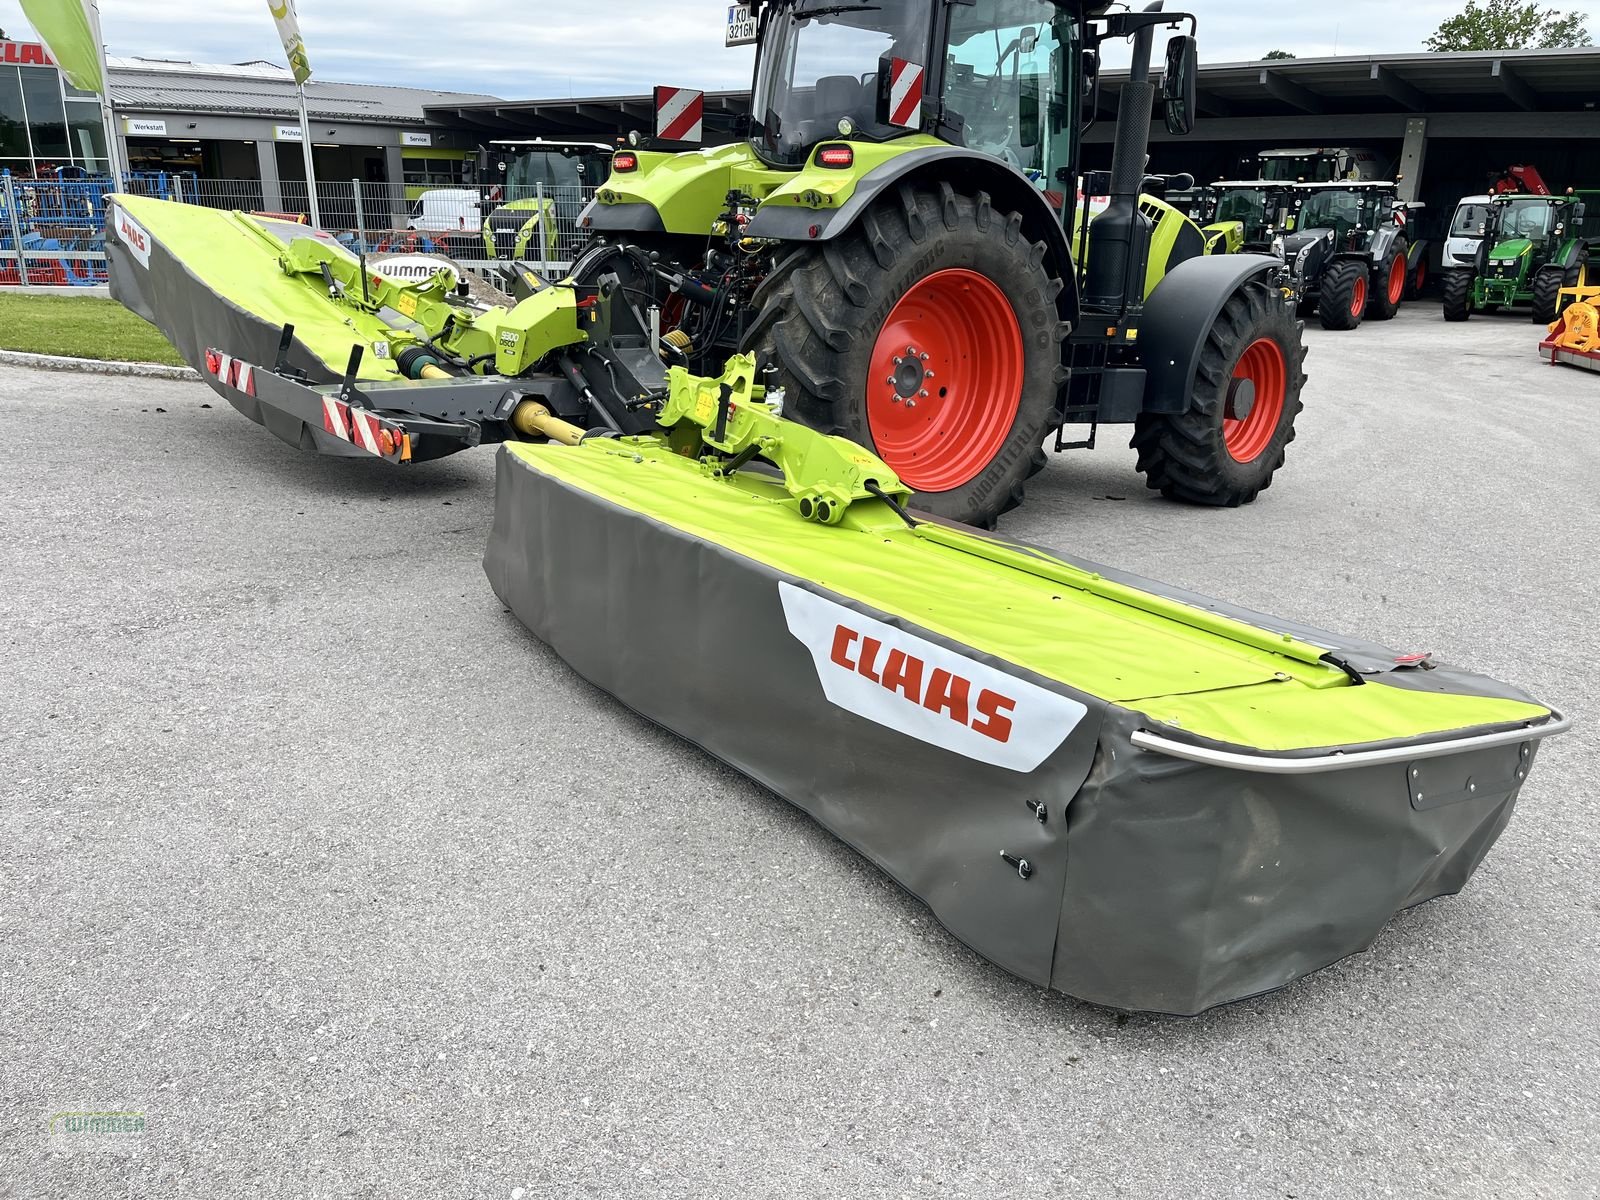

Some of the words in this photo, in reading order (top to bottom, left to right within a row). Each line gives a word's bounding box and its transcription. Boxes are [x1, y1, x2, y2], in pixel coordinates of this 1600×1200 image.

[736, 8, 747, 23] KO
[729, 22, 754, 39] 321GN
[134, 123, 164, 131] Werkstatt
[281, 129, 301, 137] Prüfsta
[409, 135, 428, 143] Service
[499, 338, 516, 348] DISCO
[830, 624, 1017, 743] CLAAS
